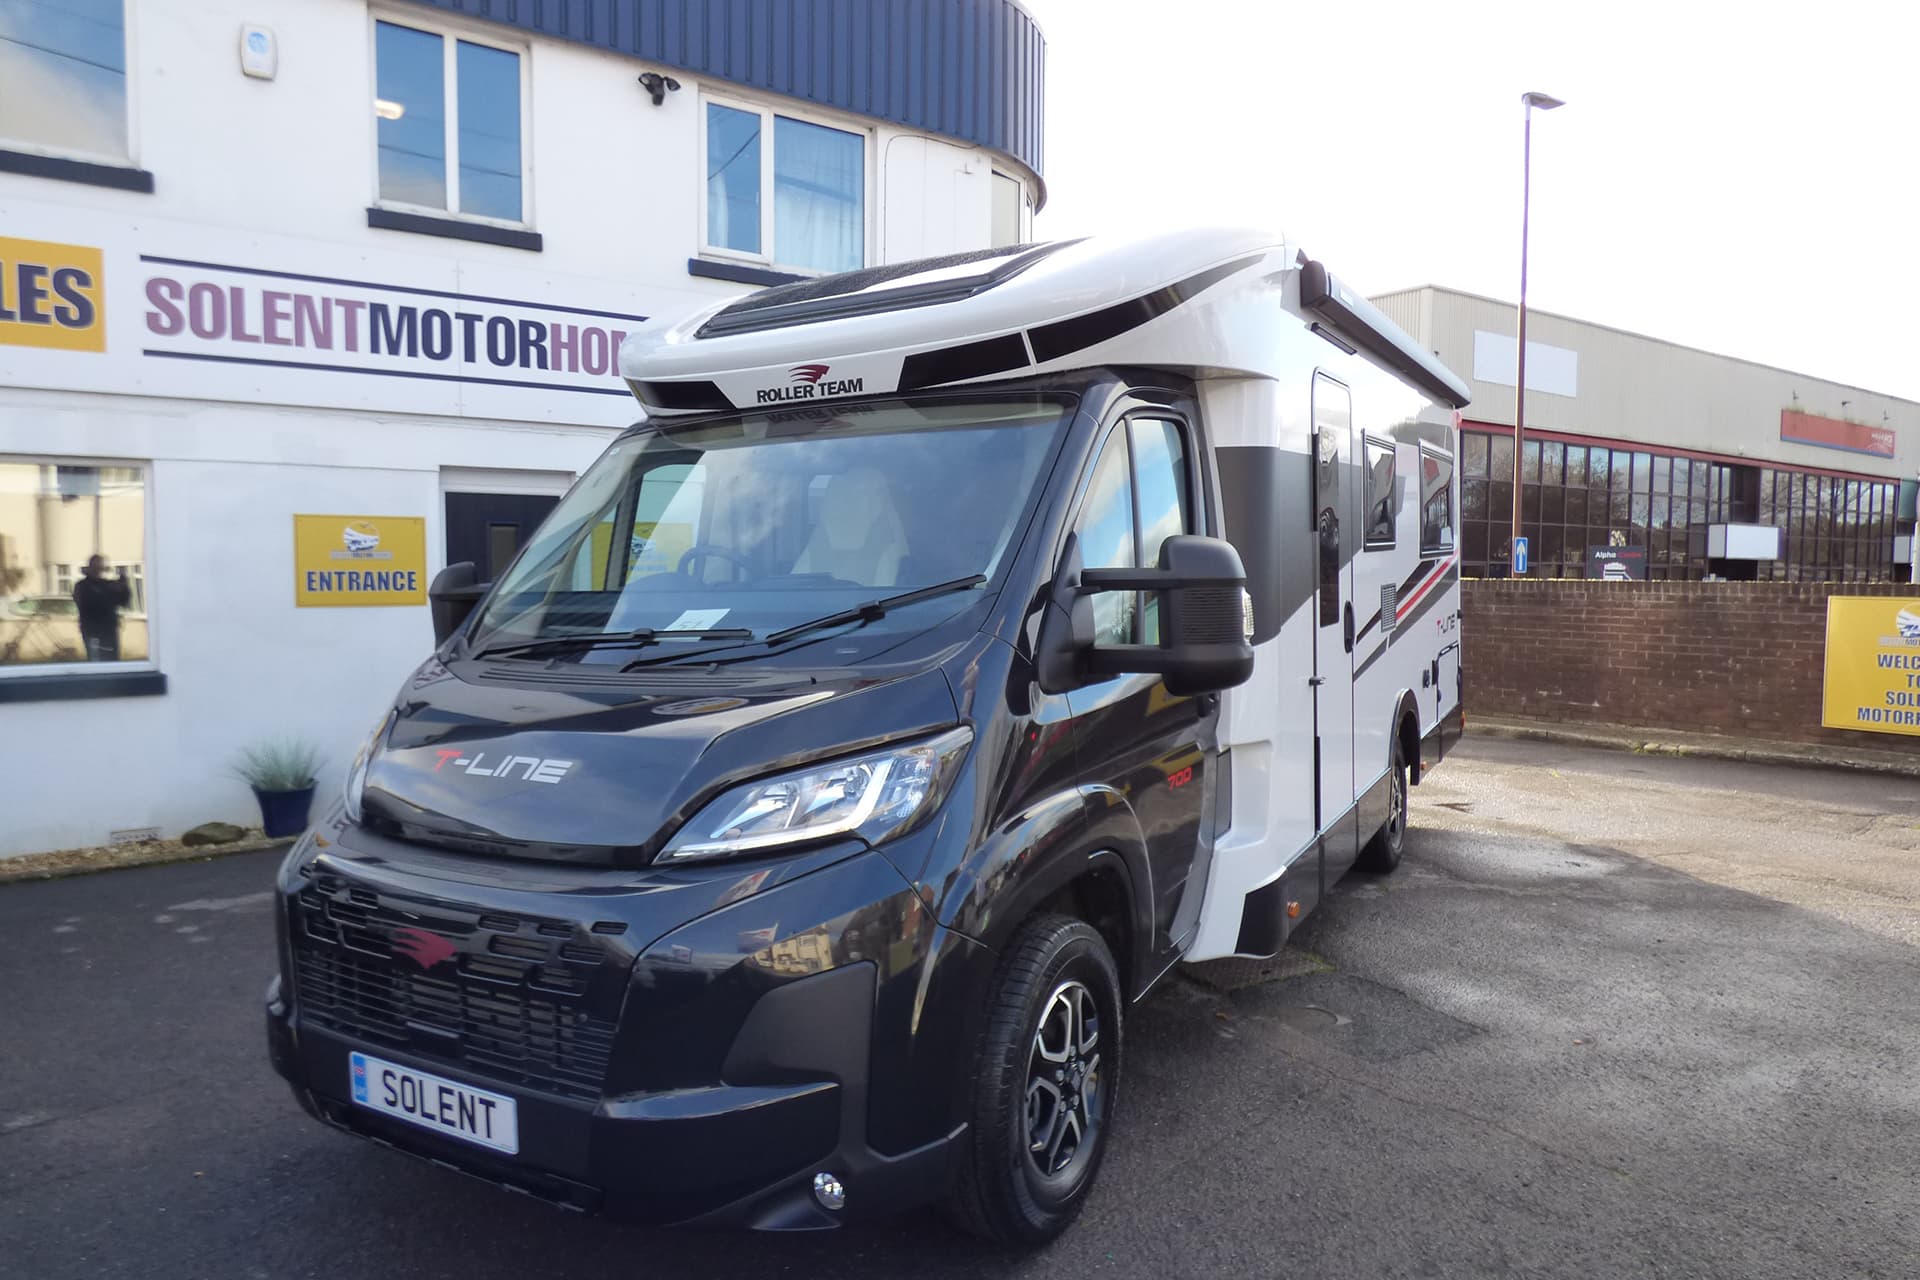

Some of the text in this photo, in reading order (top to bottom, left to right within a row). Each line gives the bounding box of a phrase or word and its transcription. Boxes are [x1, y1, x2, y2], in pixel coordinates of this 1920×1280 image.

[757, 378, 863, 403] ROLLER TEAM
[1594, 551, 1616, 559] Alpha
[306, 571, 417, 592] ENTRANCE
[434, 749, 574, 784] T-LINE
[1167, 766, 1192, 791] 700
[382, 1069, 497, 1139] SOLENT
